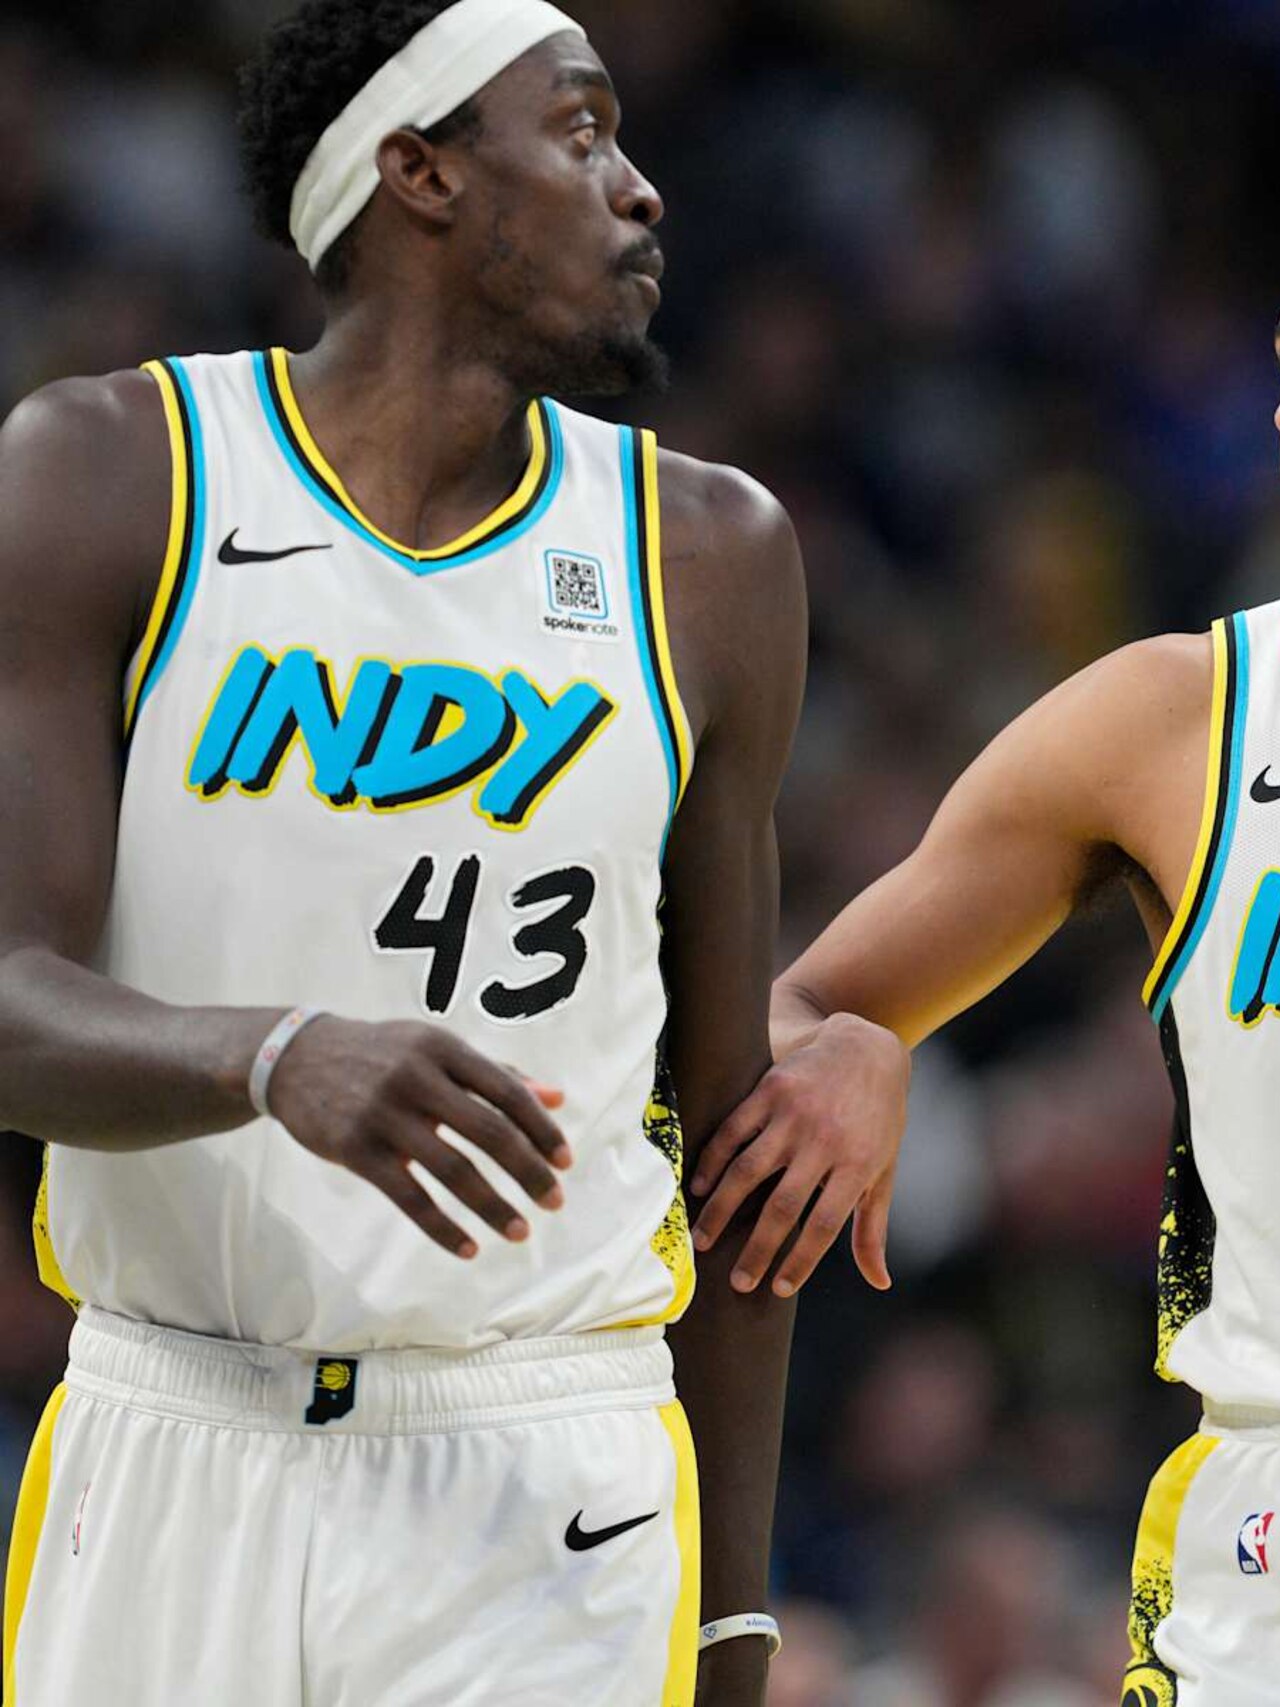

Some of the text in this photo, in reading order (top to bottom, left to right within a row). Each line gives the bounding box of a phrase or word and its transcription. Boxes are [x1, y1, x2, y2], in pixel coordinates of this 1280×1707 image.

[543, 616, 618, 636] spokenote
[184, 640, 619, 832] INDY
[373, 853, 596, 1019] 43
